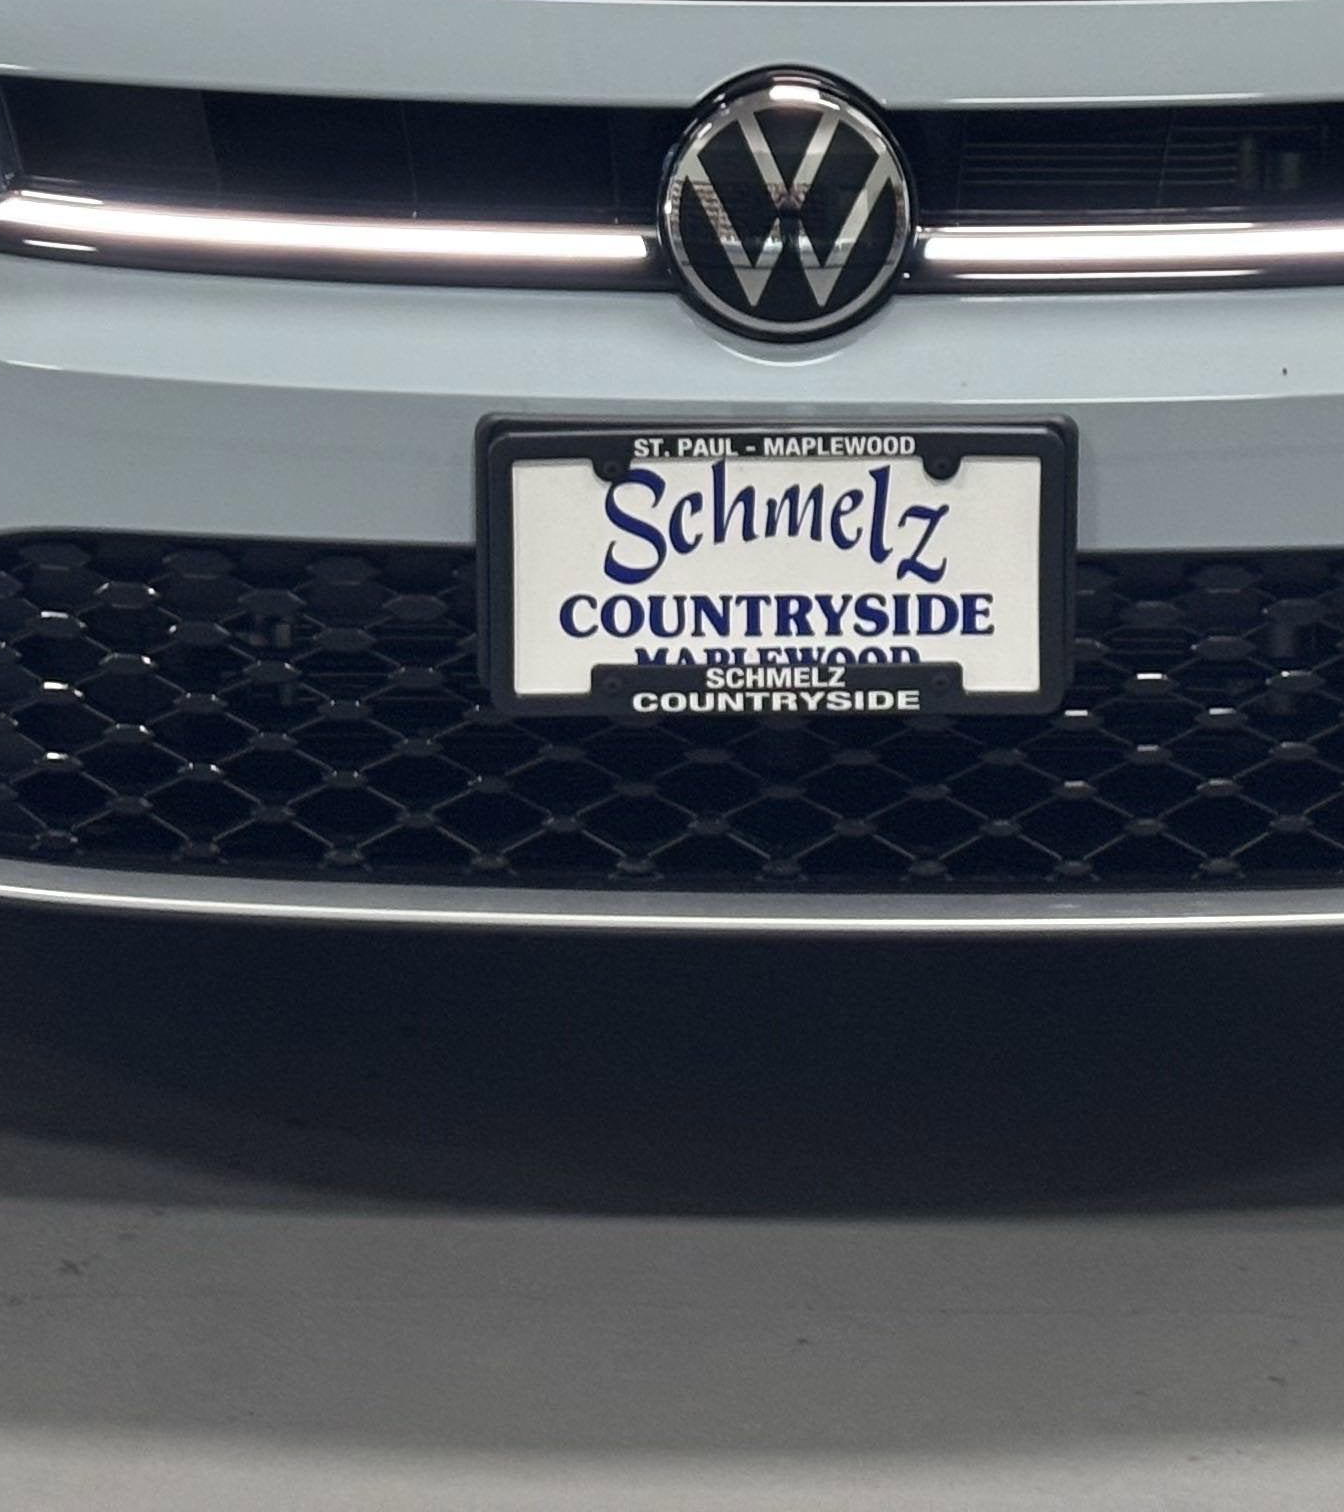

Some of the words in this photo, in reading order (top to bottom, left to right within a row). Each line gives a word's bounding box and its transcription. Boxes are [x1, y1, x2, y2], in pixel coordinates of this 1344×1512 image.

[674, 106, 900, 308] VW
[633, 438, 670, 457] ST.
[677, 438, 738, 456] PAUL
[763, 436, 916, 456] MAPLEWOOD
[604, 460, 950, 584] Schmelz
[559, 593, 995, 638] COUNTRYSIDE
[706, 666, 846, 689] SCHMELZ
[632, 690, 921, 712] COUNTRYSIDE
